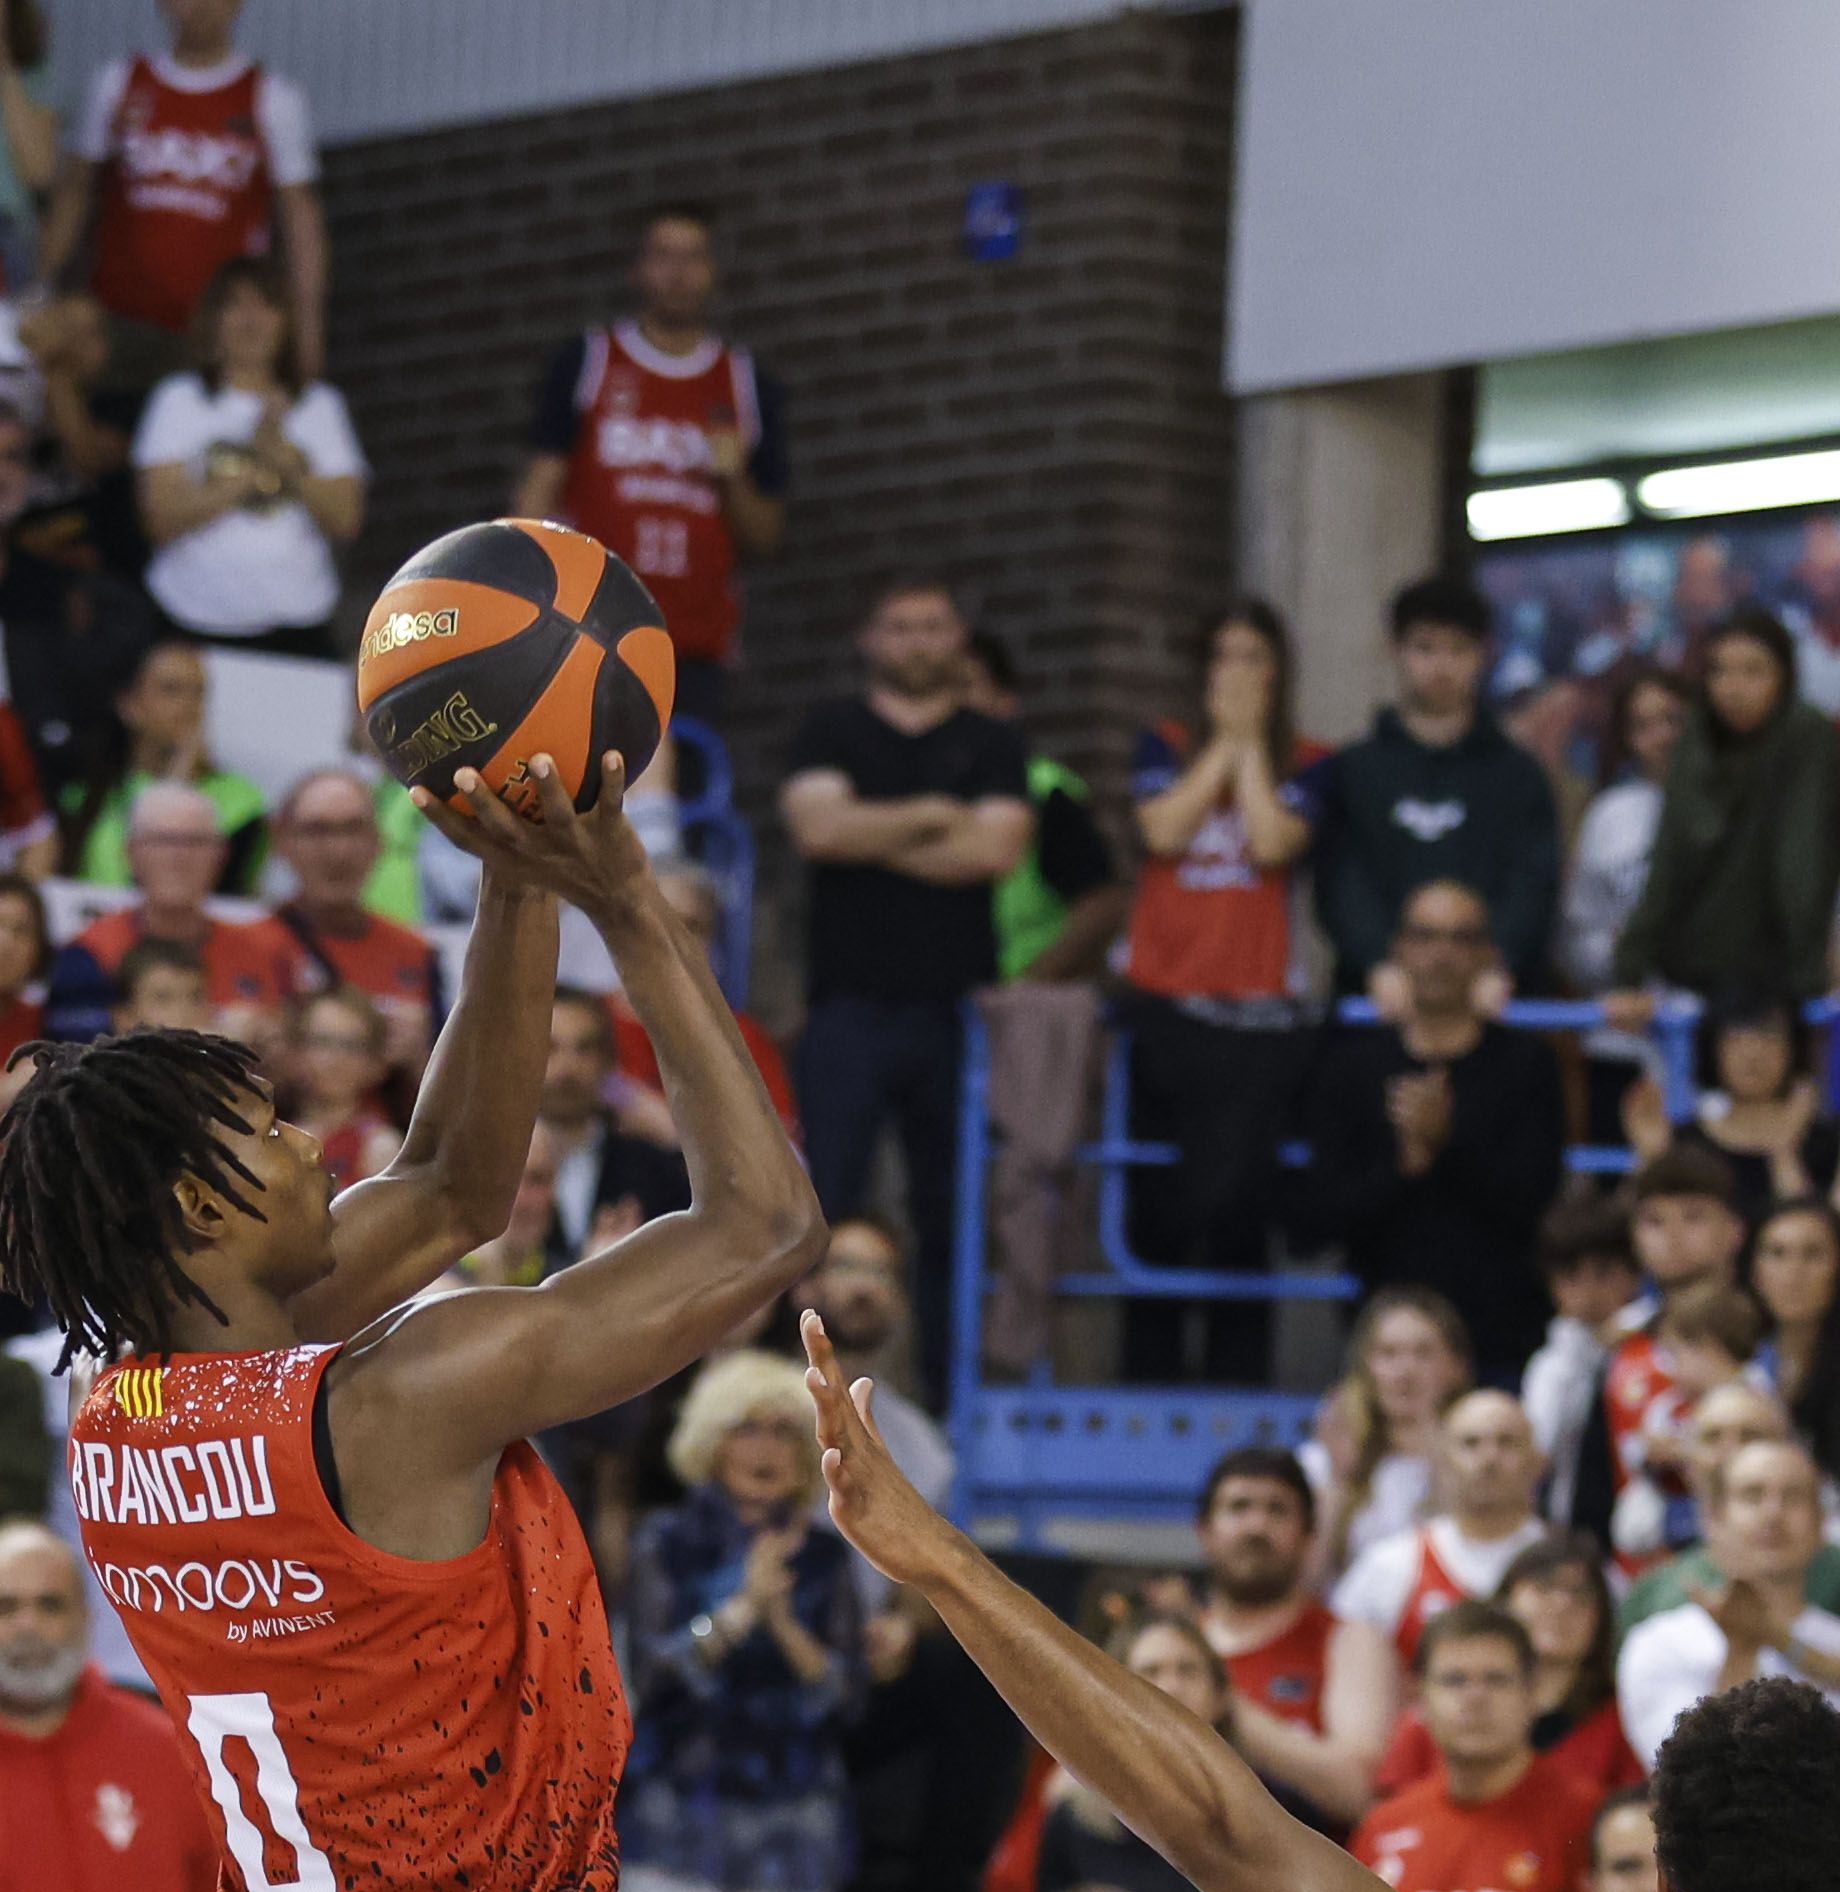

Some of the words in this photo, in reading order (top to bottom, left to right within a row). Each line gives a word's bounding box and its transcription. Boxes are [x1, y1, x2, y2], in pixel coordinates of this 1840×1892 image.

[70, 1434, 277, 1526] BRANCOU
[226, 1621, 249, 1644] by
[251, 1610, 338, 1641] AVINENT
